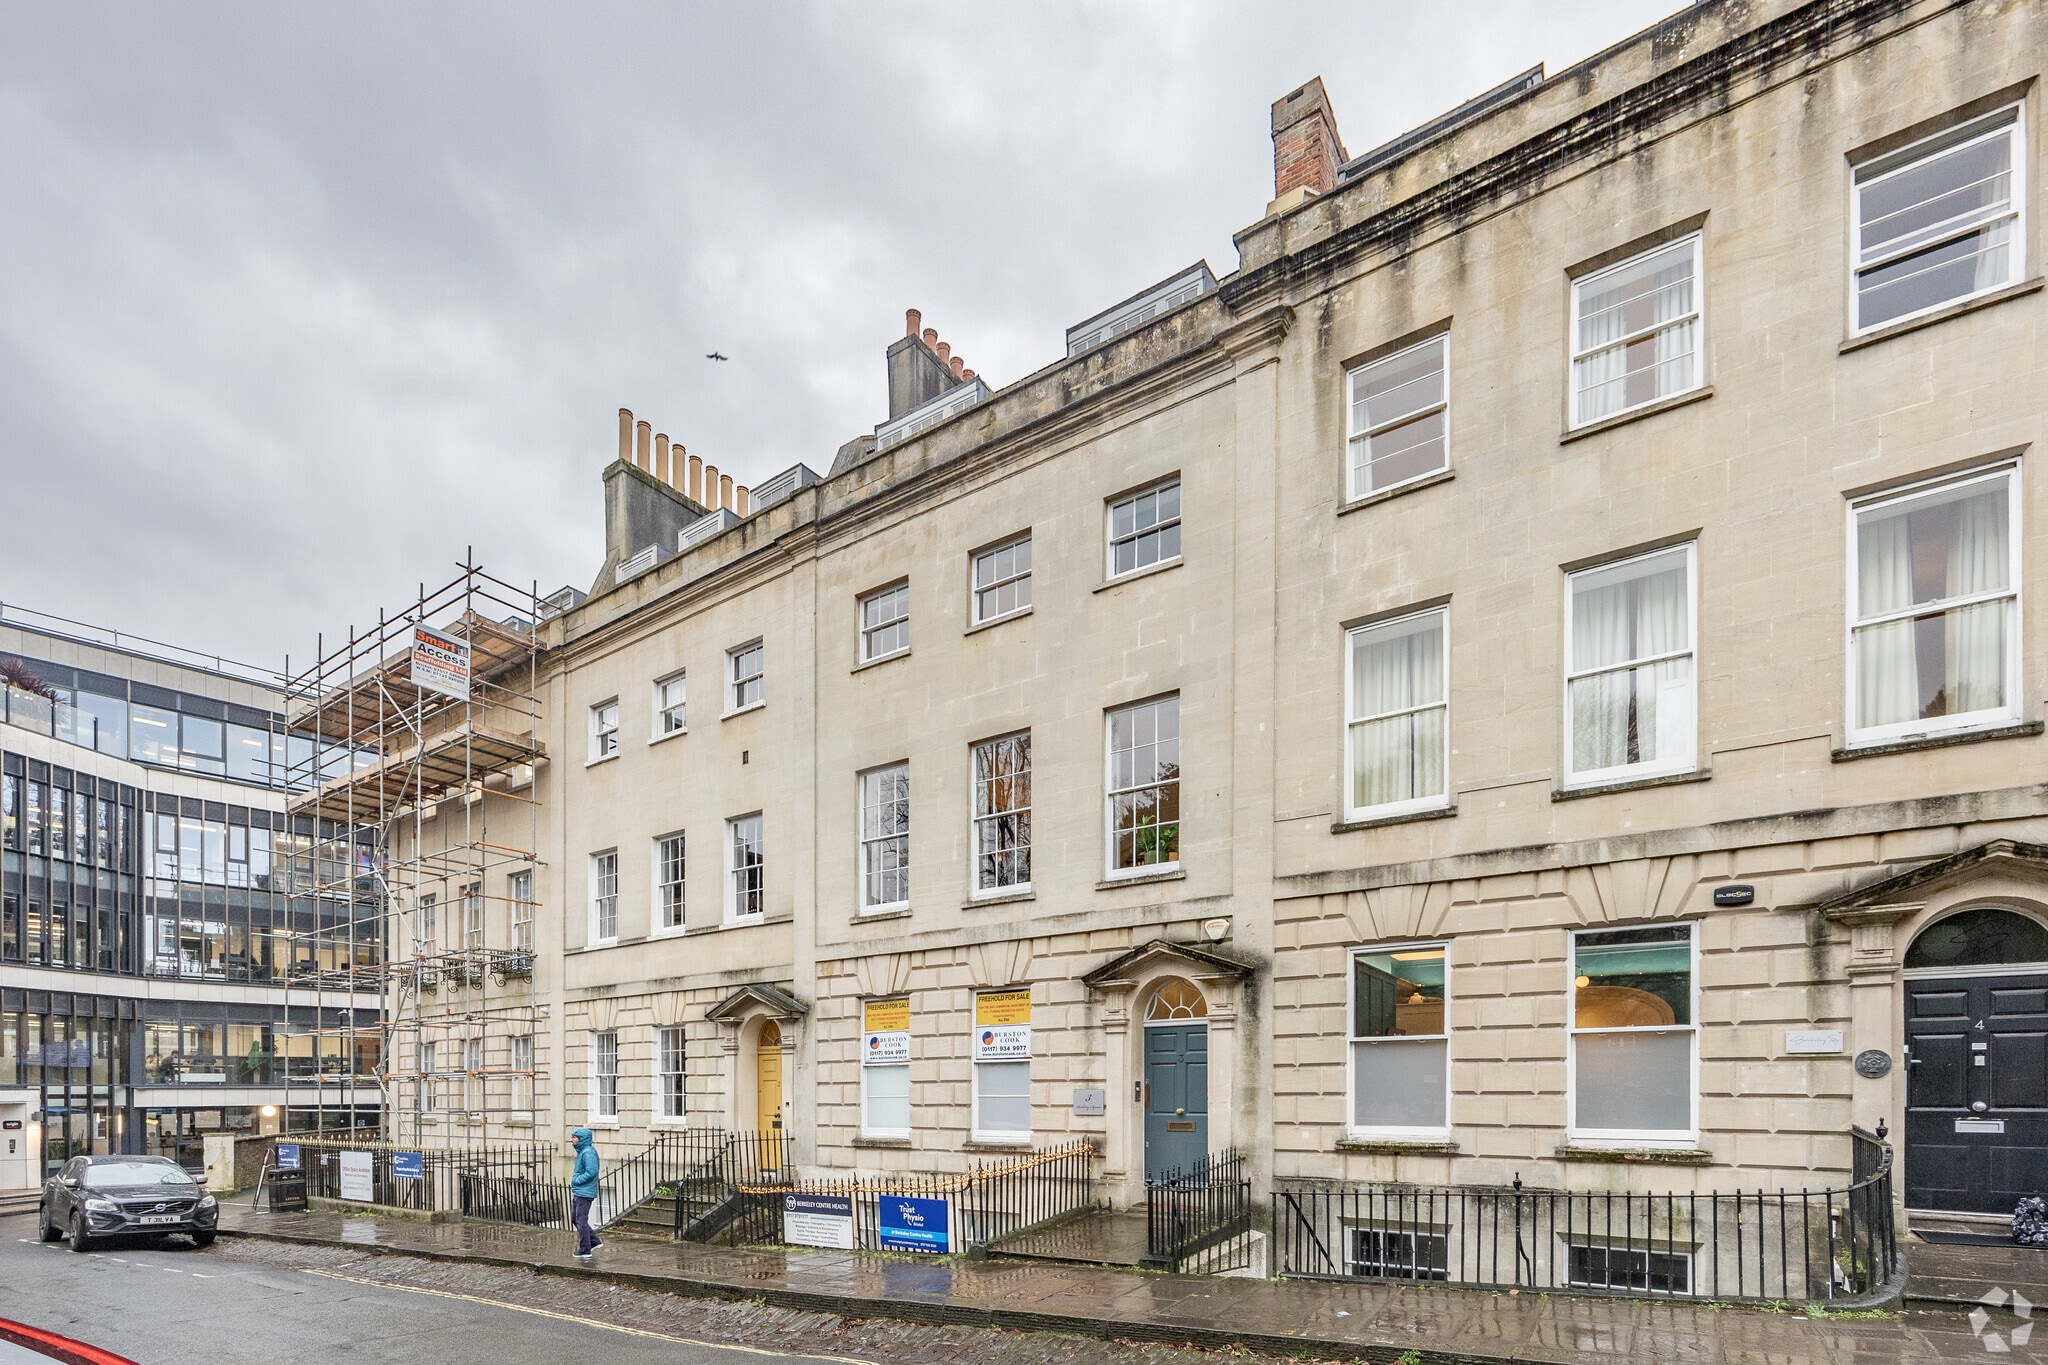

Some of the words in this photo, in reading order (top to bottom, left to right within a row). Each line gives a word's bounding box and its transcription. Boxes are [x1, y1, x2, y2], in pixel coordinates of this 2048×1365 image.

[416, 629, 456, 653] Smart
[417, 643, 466, 667] Access
[414, 653, 455, 671] Scaffolding
[455, 665, 467, 675] Ltd
[866, 1003, 889, 1011] FREEHOLD
[889, 1002, 899, 1010] FOR
[1974, 1019, 1985, 1030] 4
[1178, 1054, 1184, 1063] 3
[1084, 1094, 1092, 1102] 3
[898, 1204, 916, 1213] Trust
[902, 1212, 924, 1222] Physio
